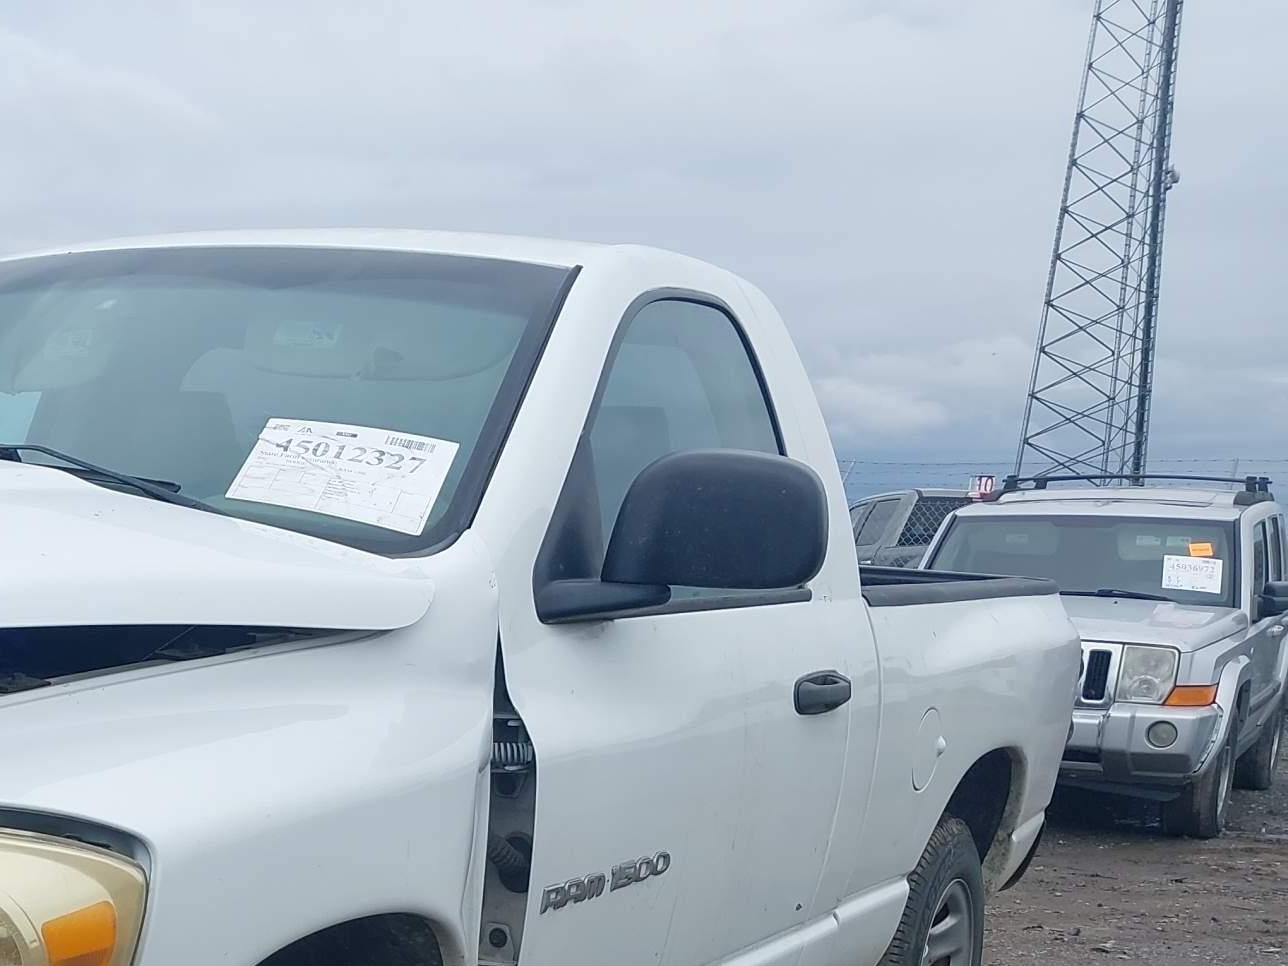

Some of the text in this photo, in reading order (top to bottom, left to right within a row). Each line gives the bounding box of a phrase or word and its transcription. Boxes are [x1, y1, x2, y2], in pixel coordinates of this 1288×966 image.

[275, 438, 428, 474] 45012327
[540, 850, 671, 915] RAM 1500
